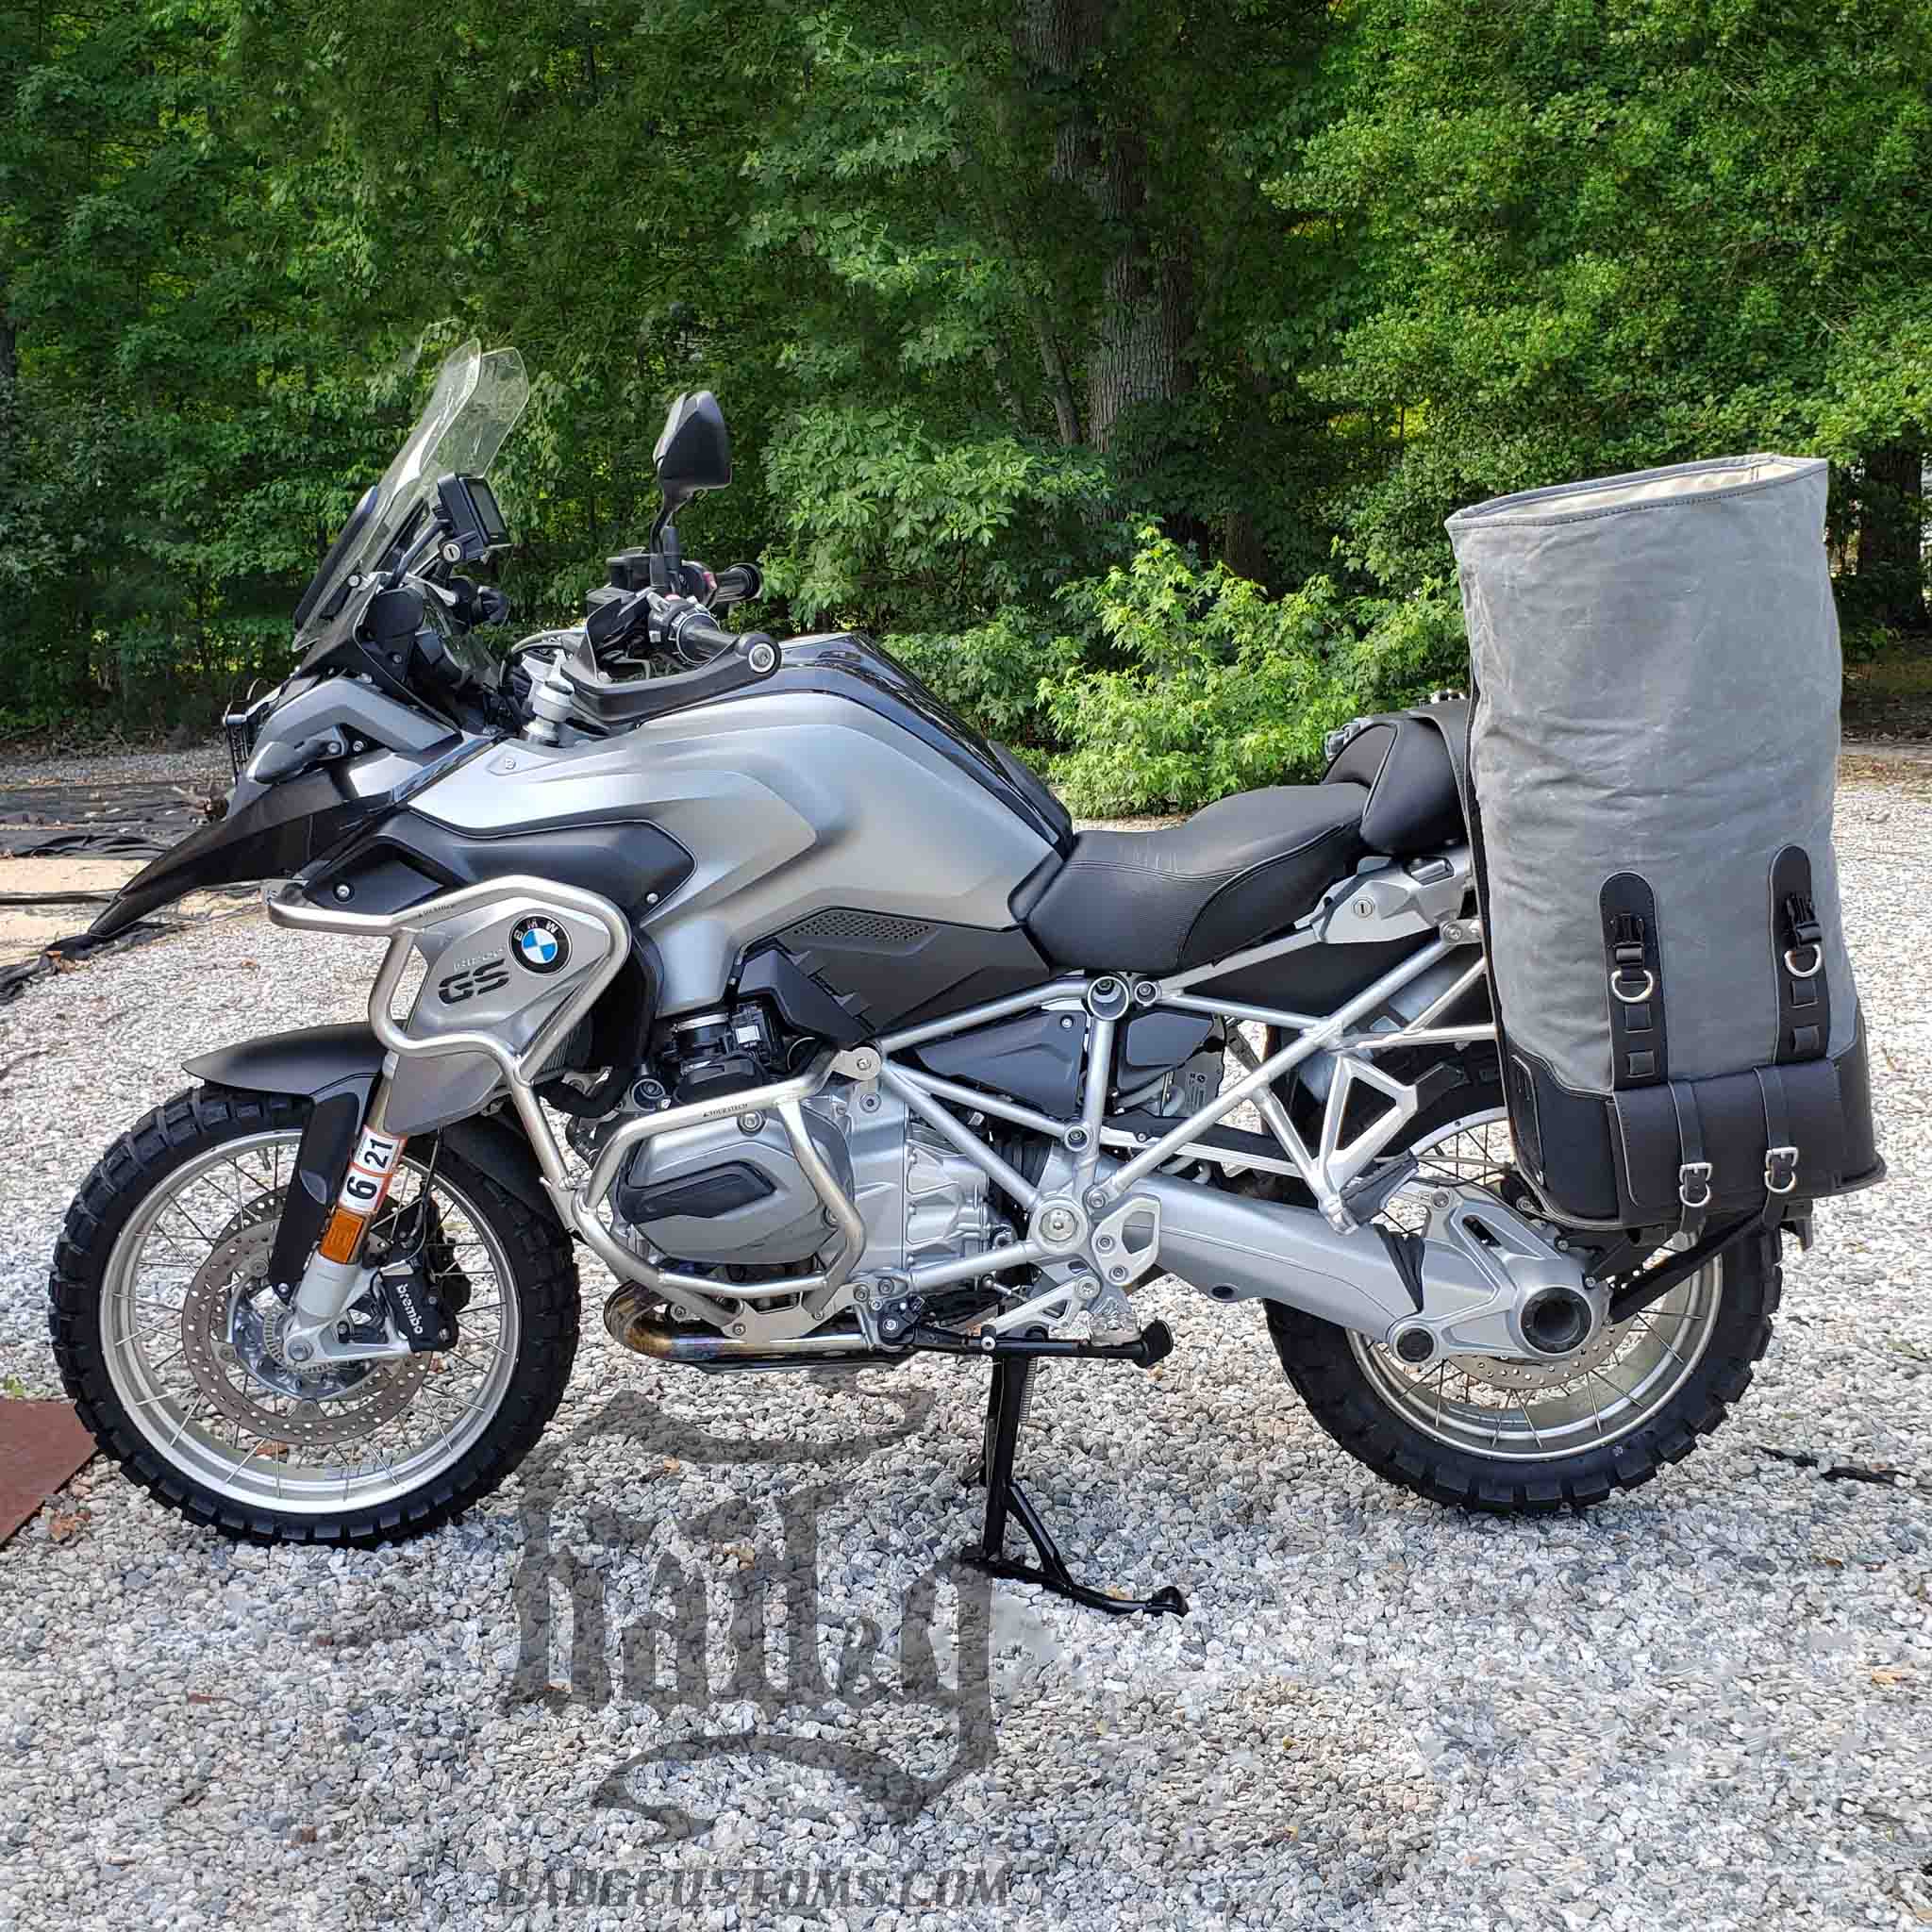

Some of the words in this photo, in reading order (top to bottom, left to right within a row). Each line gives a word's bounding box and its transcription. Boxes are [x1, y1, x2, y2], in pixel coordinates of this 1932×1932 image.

[513, 918, 559, 941] BMW
[438, 958, 510, 1005] GS
[346, 1175, 378, 1200] 6
[363, 1138, 393, 1169] 21
[396, 1283, 424, 1335] brembo
